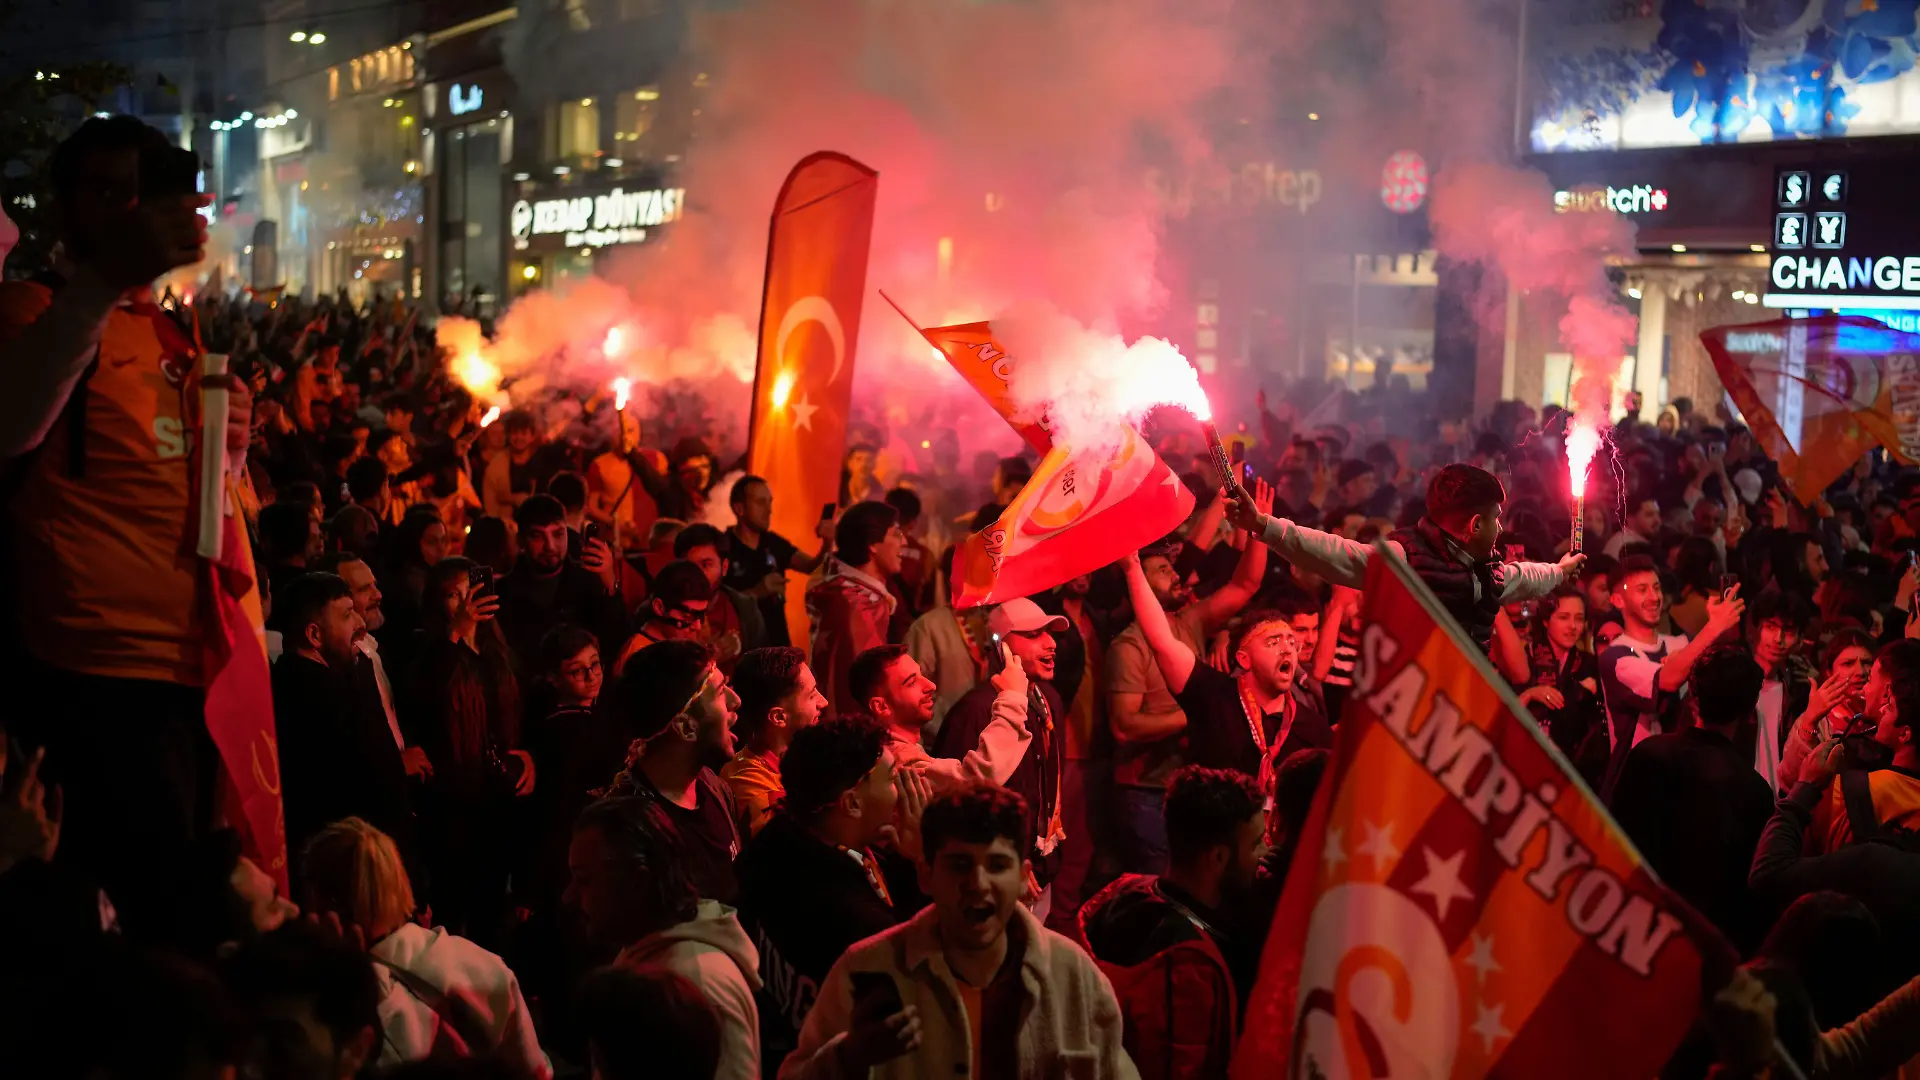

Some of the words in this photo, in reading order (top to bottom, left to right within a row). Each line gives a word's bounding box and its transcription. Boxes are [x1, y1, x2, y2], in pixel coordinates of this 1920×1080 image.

[532, 197, 594, 234] KEBAP
[1772, 256, 1920, 290] CHANGE
[1351, 624, 1683, 976] ŞAMPİYON
